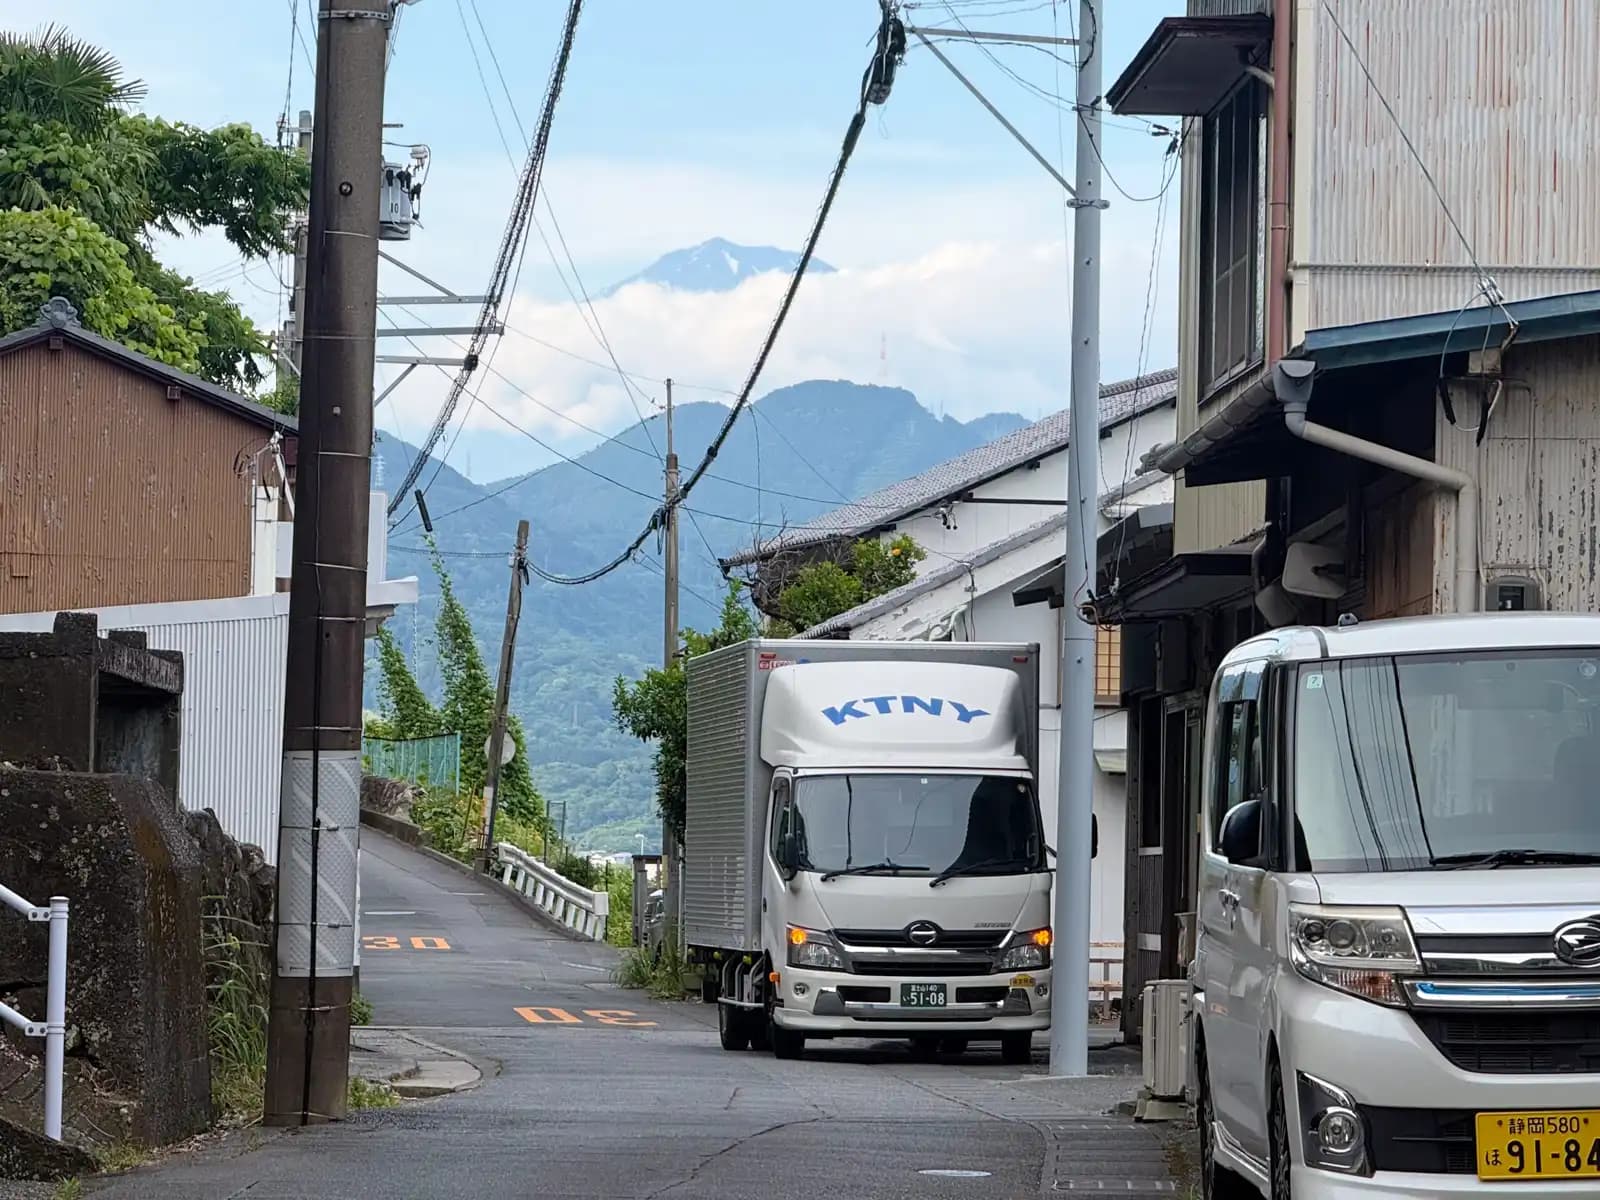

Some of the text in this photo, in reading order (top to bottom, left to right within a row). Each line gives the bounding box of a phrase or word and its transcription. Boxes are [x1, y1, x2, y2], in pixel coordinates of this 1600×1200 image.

[390, 203, 399, 214] 10
[821, 695, 991, 726] KTNY
[361, 936, 451, 950] 30
[910, 992, 945, 1005] 51-08
[513, 1006, 658, 1027] 30
[1508, 1116, 1580, 1135] 静岡580
[1485, 1149, 1502, 1166] ほ
